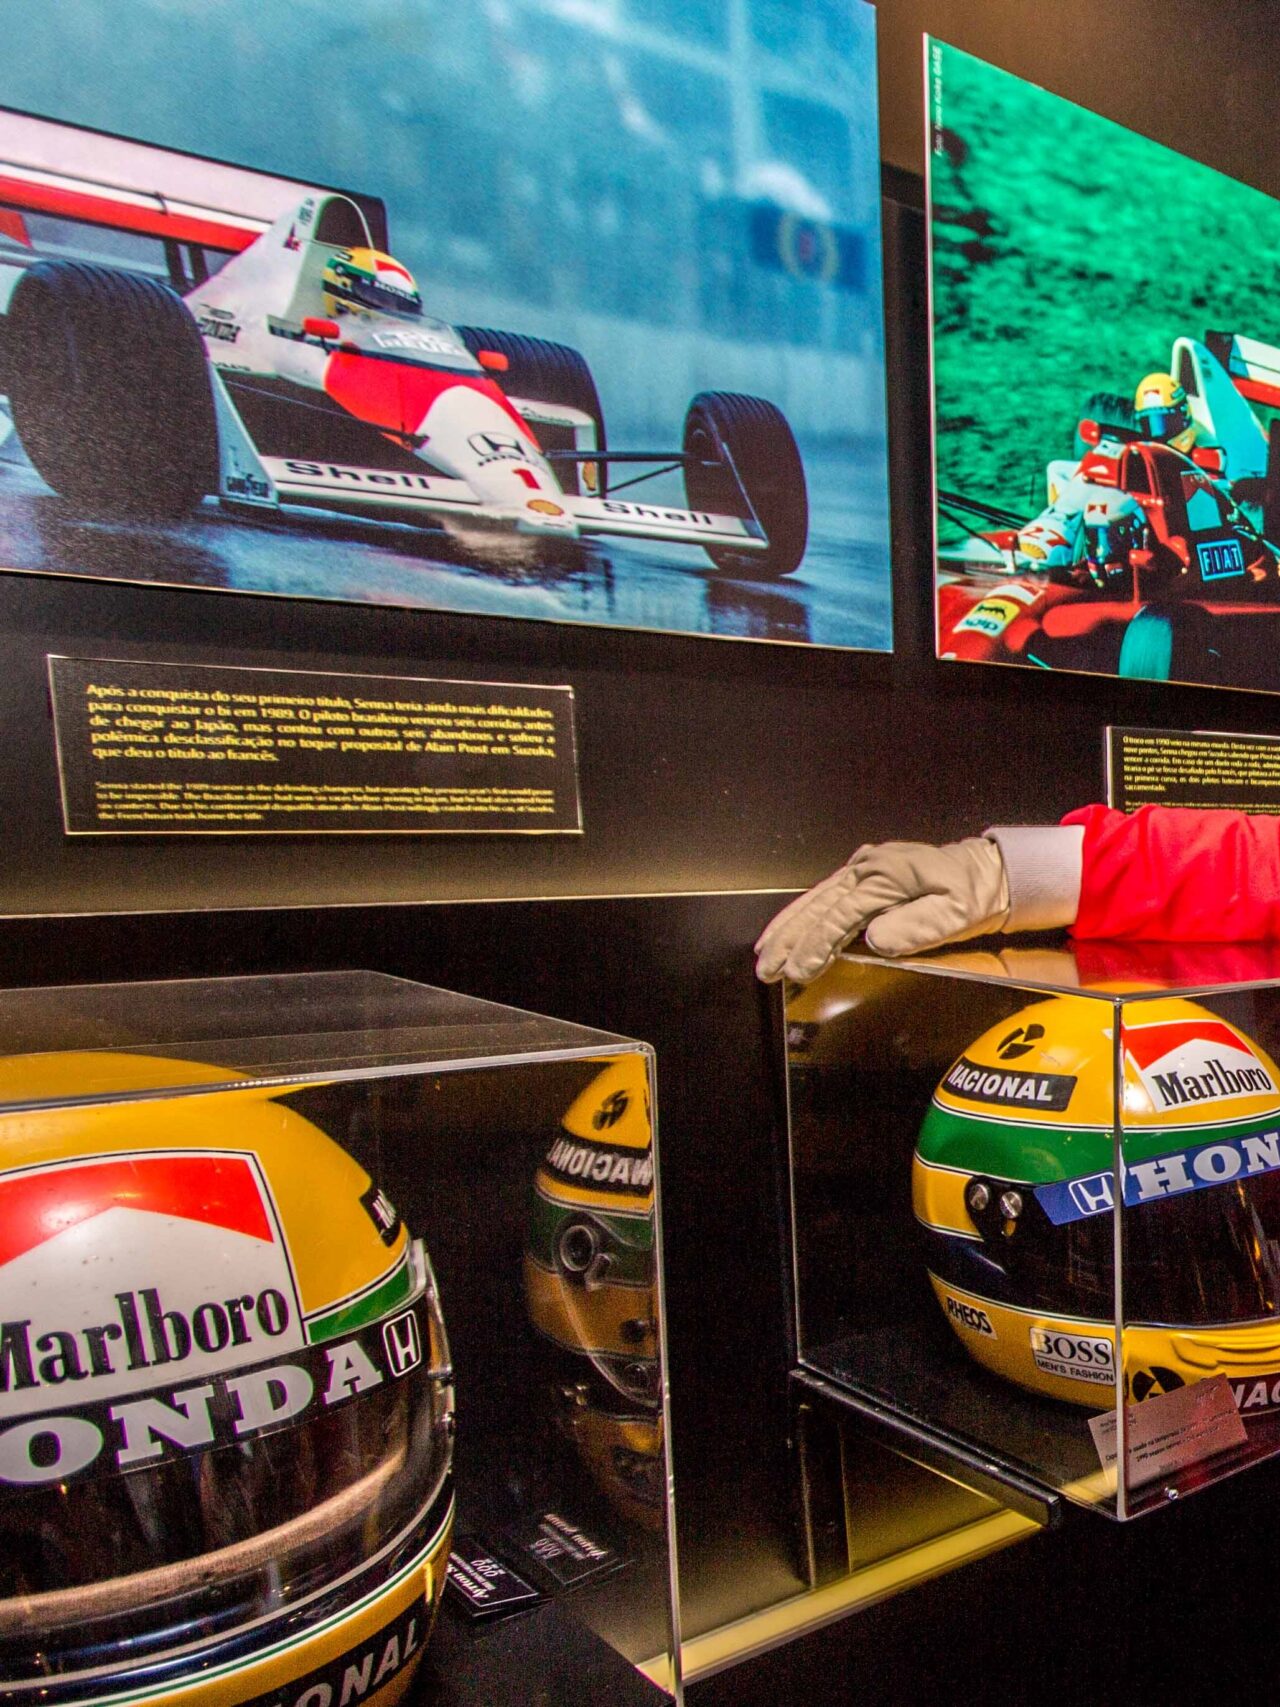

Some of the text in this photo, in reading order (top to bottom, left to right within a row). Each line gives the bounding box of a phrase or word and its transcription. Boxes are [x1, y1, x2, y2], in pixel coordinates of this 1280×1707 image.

[285, 461, 431, 489] Shell
[513, 468, 542, 489] 1
[602, 501, 713, 525] Shell
[1202, 547, 1240, 572] FIAT
[948, 1064, 1053, 1102] NACIONAL
[1151, 1059, 1272, 1107] Marlboro
[1034, 1331, 1111, 1365] BOSS
[1070, 1366, 1114, 1382] FASHION
